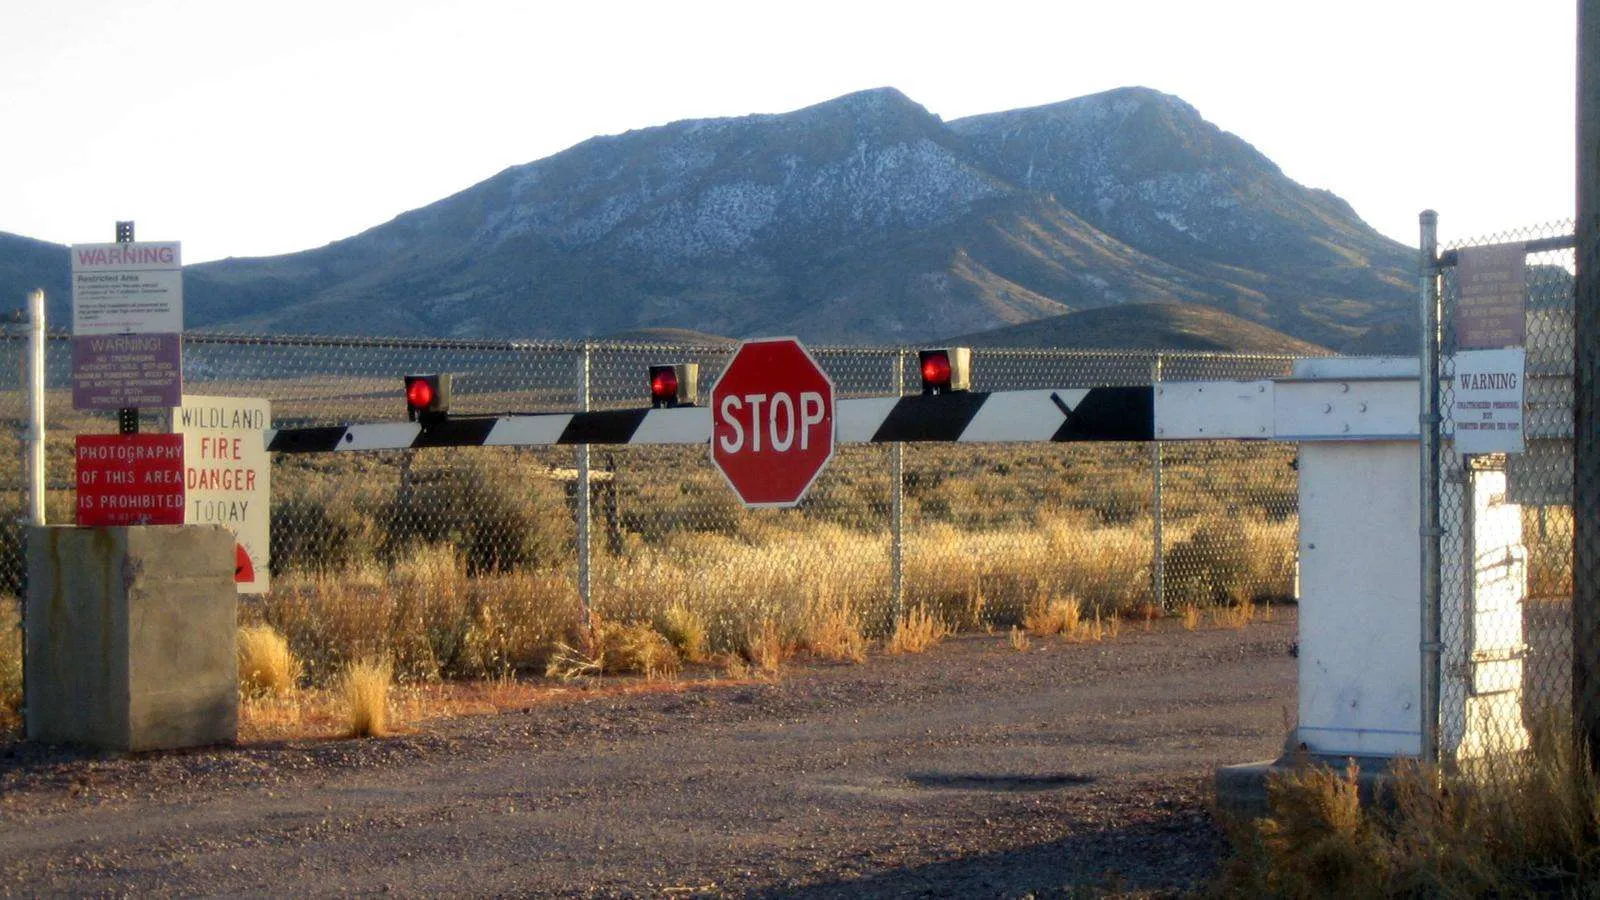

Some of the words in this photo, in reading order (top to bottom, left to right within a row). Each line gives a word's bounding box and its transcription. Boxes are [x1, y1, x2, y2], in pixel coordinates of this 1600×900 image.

[79, 246, 173, 266] WARNING
[90, 339, 161, 353] WARNING!
[1460, 372, 1517, 390] WARNING
[182, 407, 264, 429] WILDLAND
[720, 391, 825, 454] STOP
[80, 446, 183, 460] PHOTOGRAPHY
[201, 437, 242, 460] FIRE
[81, 470, 98, 484] OF
[105, 470, 136, 484] THIS
[144, 470, 183, 483] AREA
[187, 468, 256, 490] DANGER
[80, 495, 94, 508] IS
[100, 495, 184, 508] PROHIBITED
[194, 500, 249, 521] TODAY
